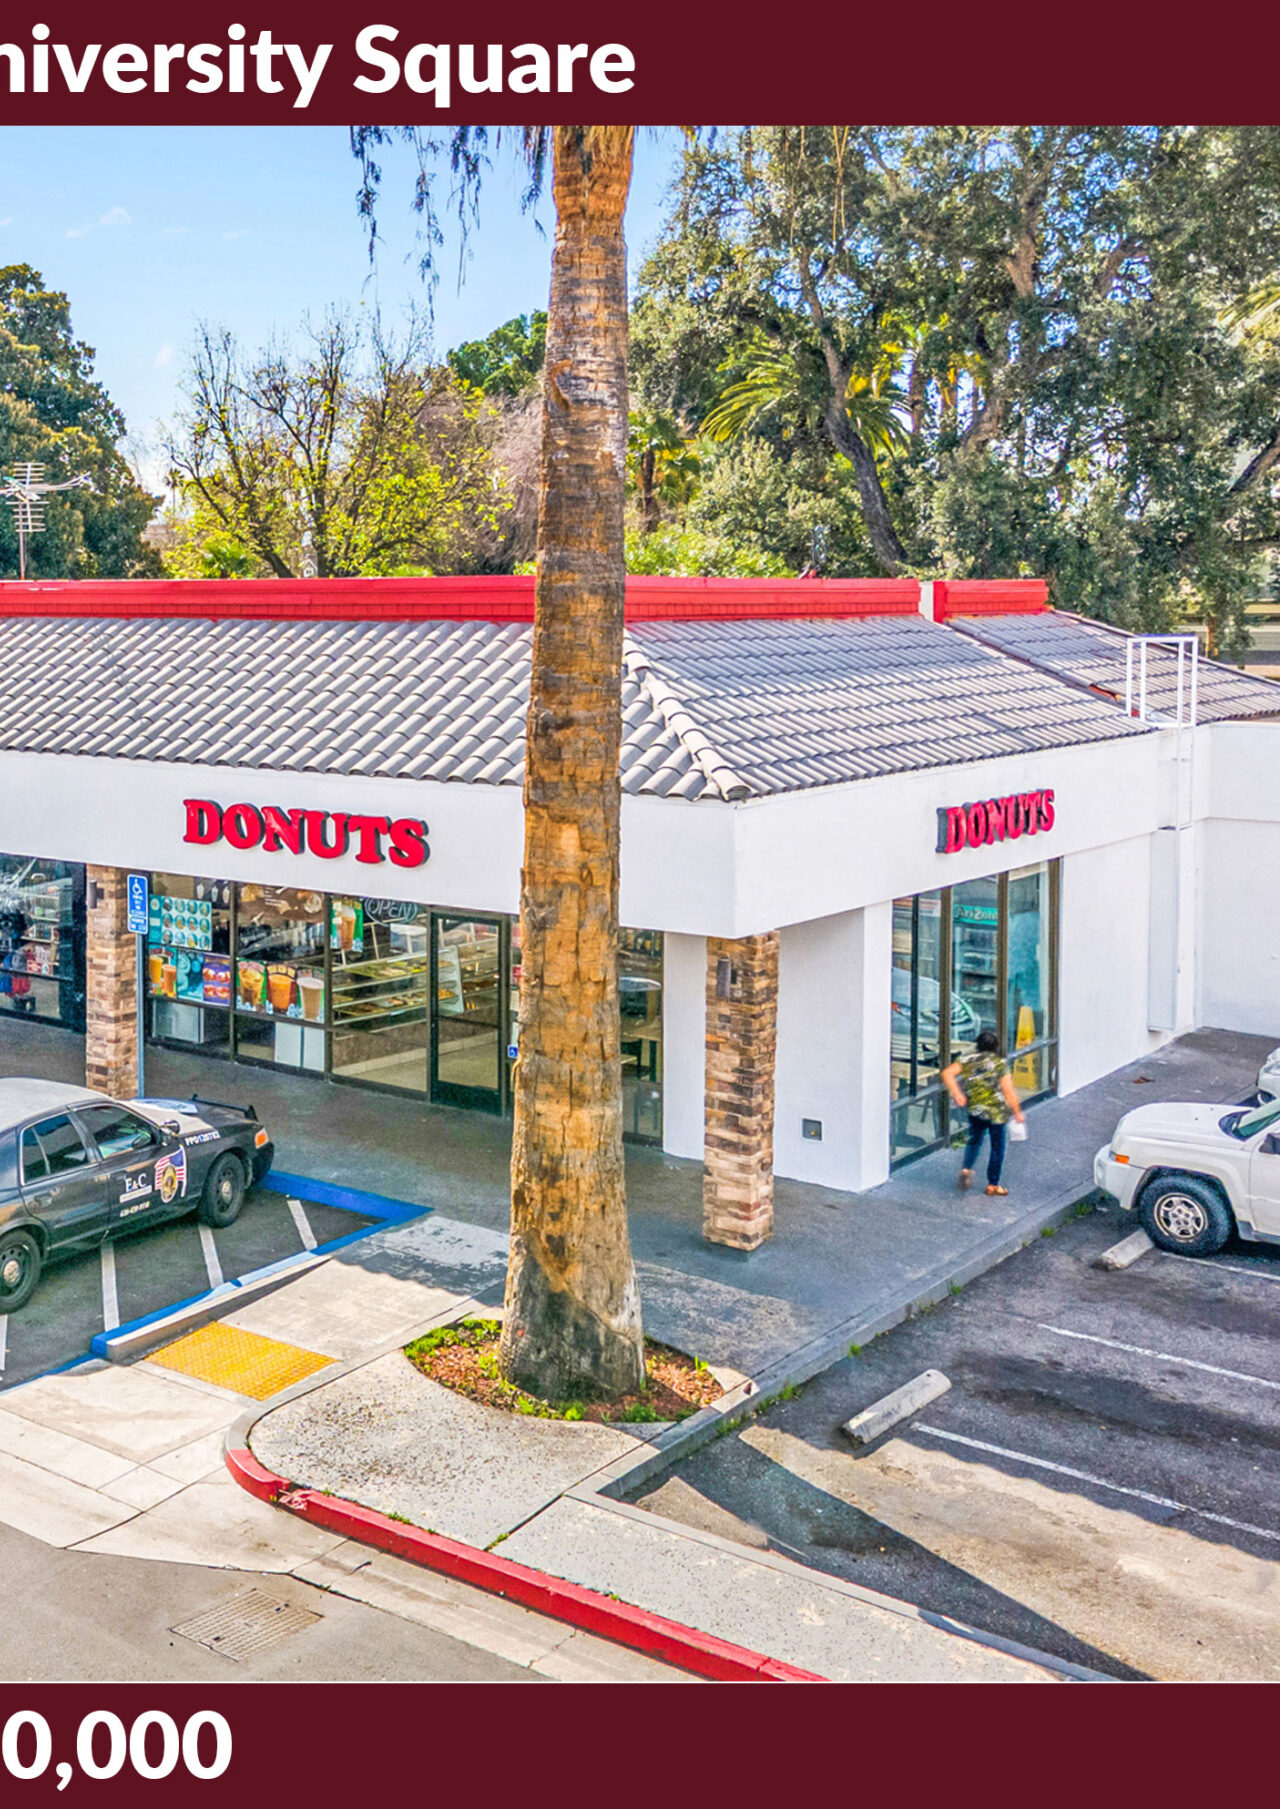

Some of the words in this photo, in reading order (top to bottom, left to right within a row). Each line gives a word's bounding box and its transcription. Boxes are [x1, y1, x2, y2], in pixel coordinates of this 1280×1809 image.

[183, 798, 429, 868] DONUTS
[936, 789, 1055, 854] DONUTS
[371, 899, 413, 920] OPEN
